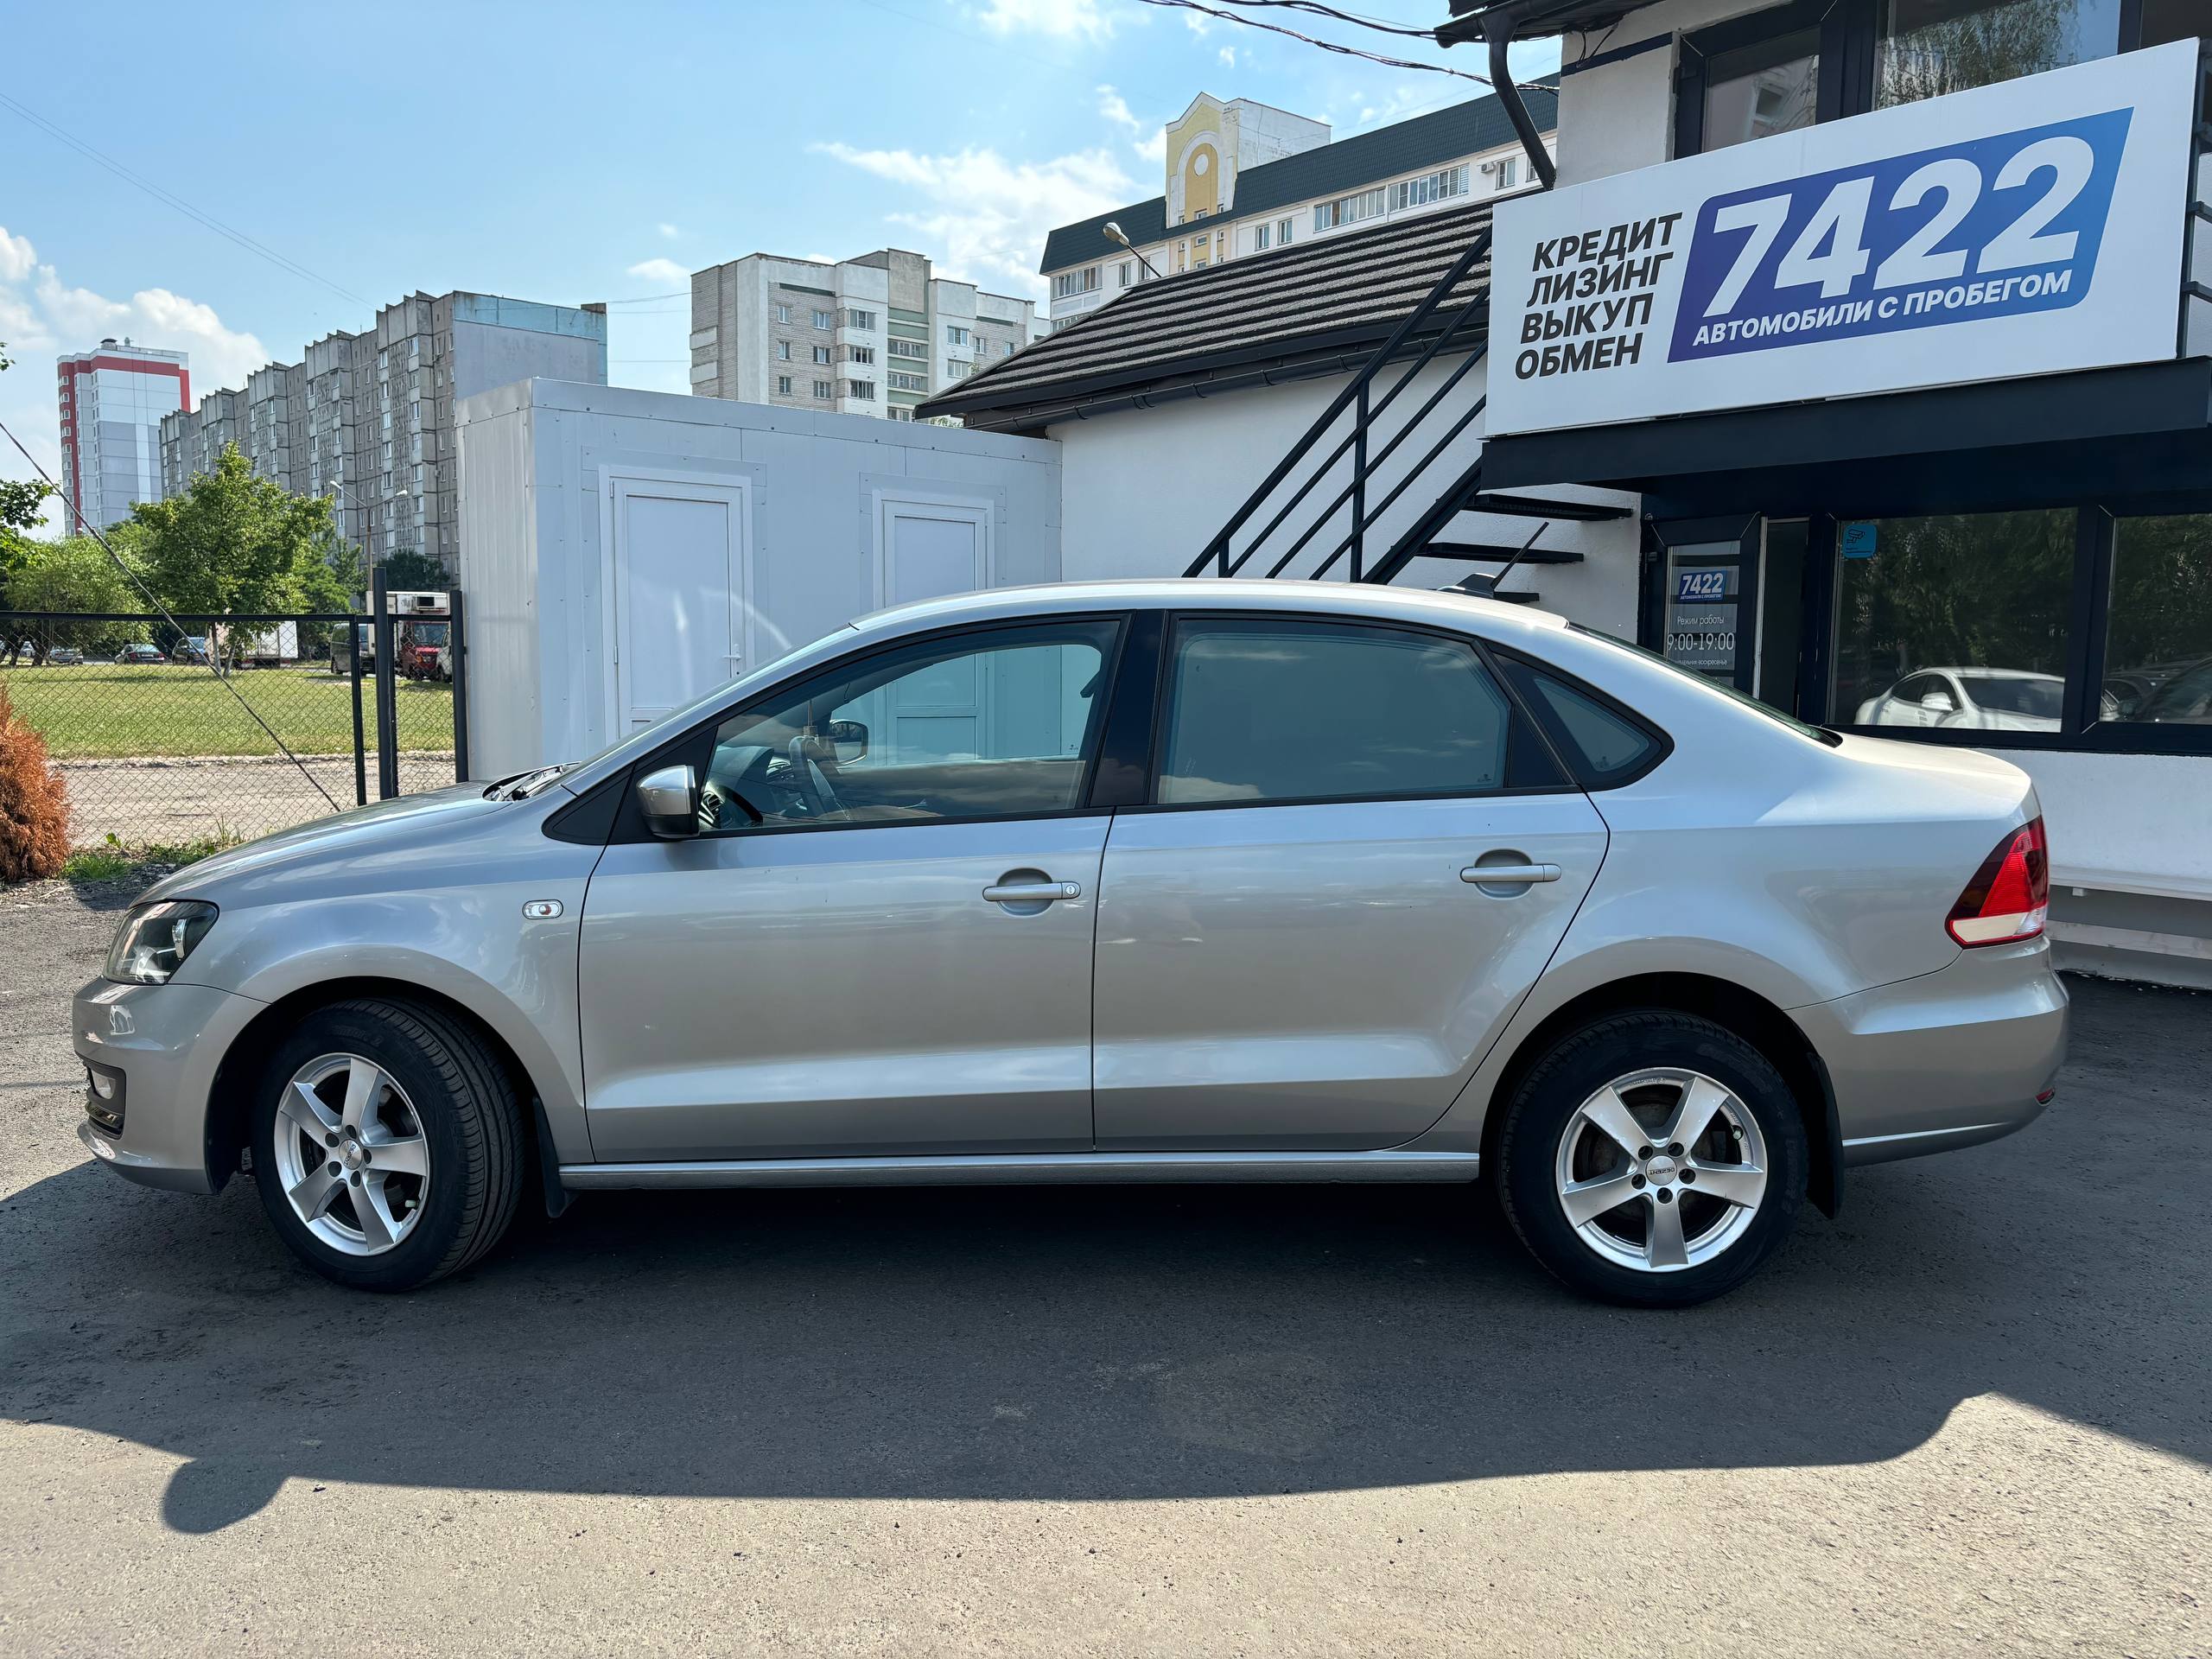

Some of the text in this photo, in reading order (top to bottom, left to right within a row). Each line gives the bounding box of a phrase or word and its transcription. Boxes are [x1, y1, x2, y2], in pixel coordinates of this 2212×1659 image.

[1532, 212, 1683, 272] КРЕДИТ
[1703, 136, 2094, 318] 7422
[1526, 251, 1675, 308] ЛИЗИНГ
[1520, 292, 1655, 345] ВЫКУП
[1692, 269, 2073, 346] АВТОМОБИЛИ С ПРОБЕГОМ
[1515, 332, 1643, 380] ОБМЕН
[1681, 572, 1724, 595] 7422
[1667, 632, 1735, 651] 9:00-19:00
[1677, 613, 1725, 626] Режим работы
